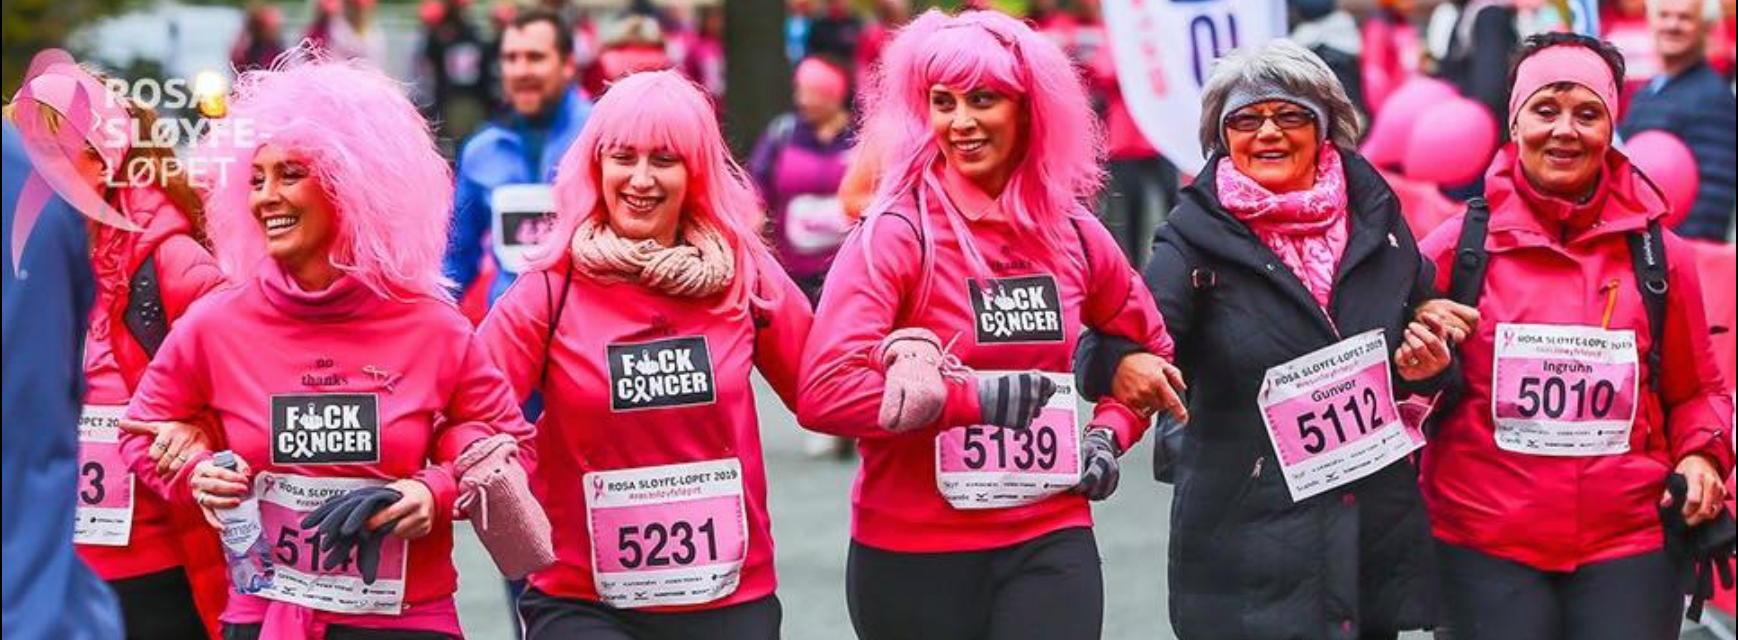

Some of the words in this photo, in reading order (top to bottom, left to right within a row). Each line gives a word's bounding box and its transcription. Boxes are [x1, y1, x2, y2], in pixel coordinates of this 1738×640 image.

[301, 373, 348, 387] thanks
[1275, 372, 1300, 387] ROSA
[1311, 379, 1357, 403] Gunvor
[1517, 376, 1615, 419] 5010
[1297, 387, 1384, 455] 5112
[964, 426, 1057, 470] 5139
[279, 482, 305, 496] ROSA
[608, 481, 636, 492] ROSA
[714, 469, 738, 481] 2019
[618, 517, 717, 569] 5231
